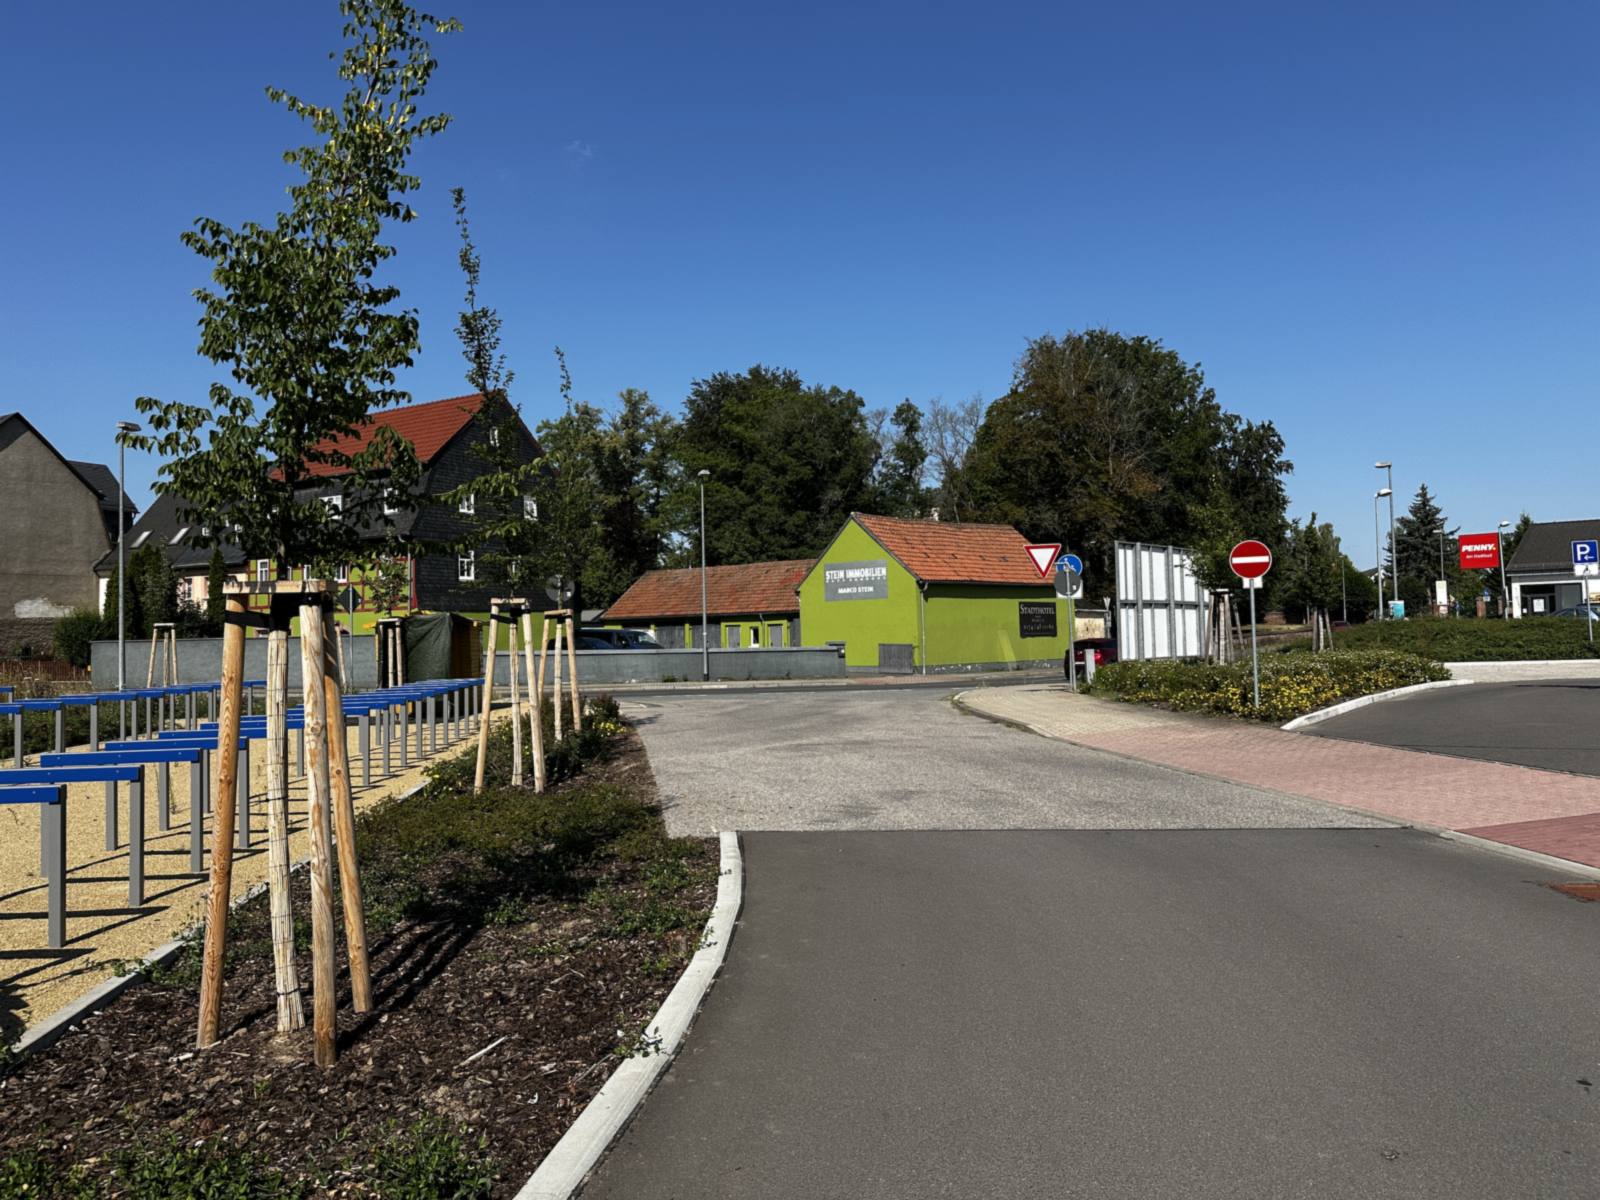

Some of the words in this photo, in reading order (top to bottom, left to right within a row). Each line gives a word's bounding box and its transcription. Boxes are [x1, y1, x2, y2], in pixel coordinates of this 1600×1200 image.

[1576, 543, 1591, 561] P
[825, 570, 844, 580] STEIN
[845, 567, 887, 578] IMMOBILIEN
